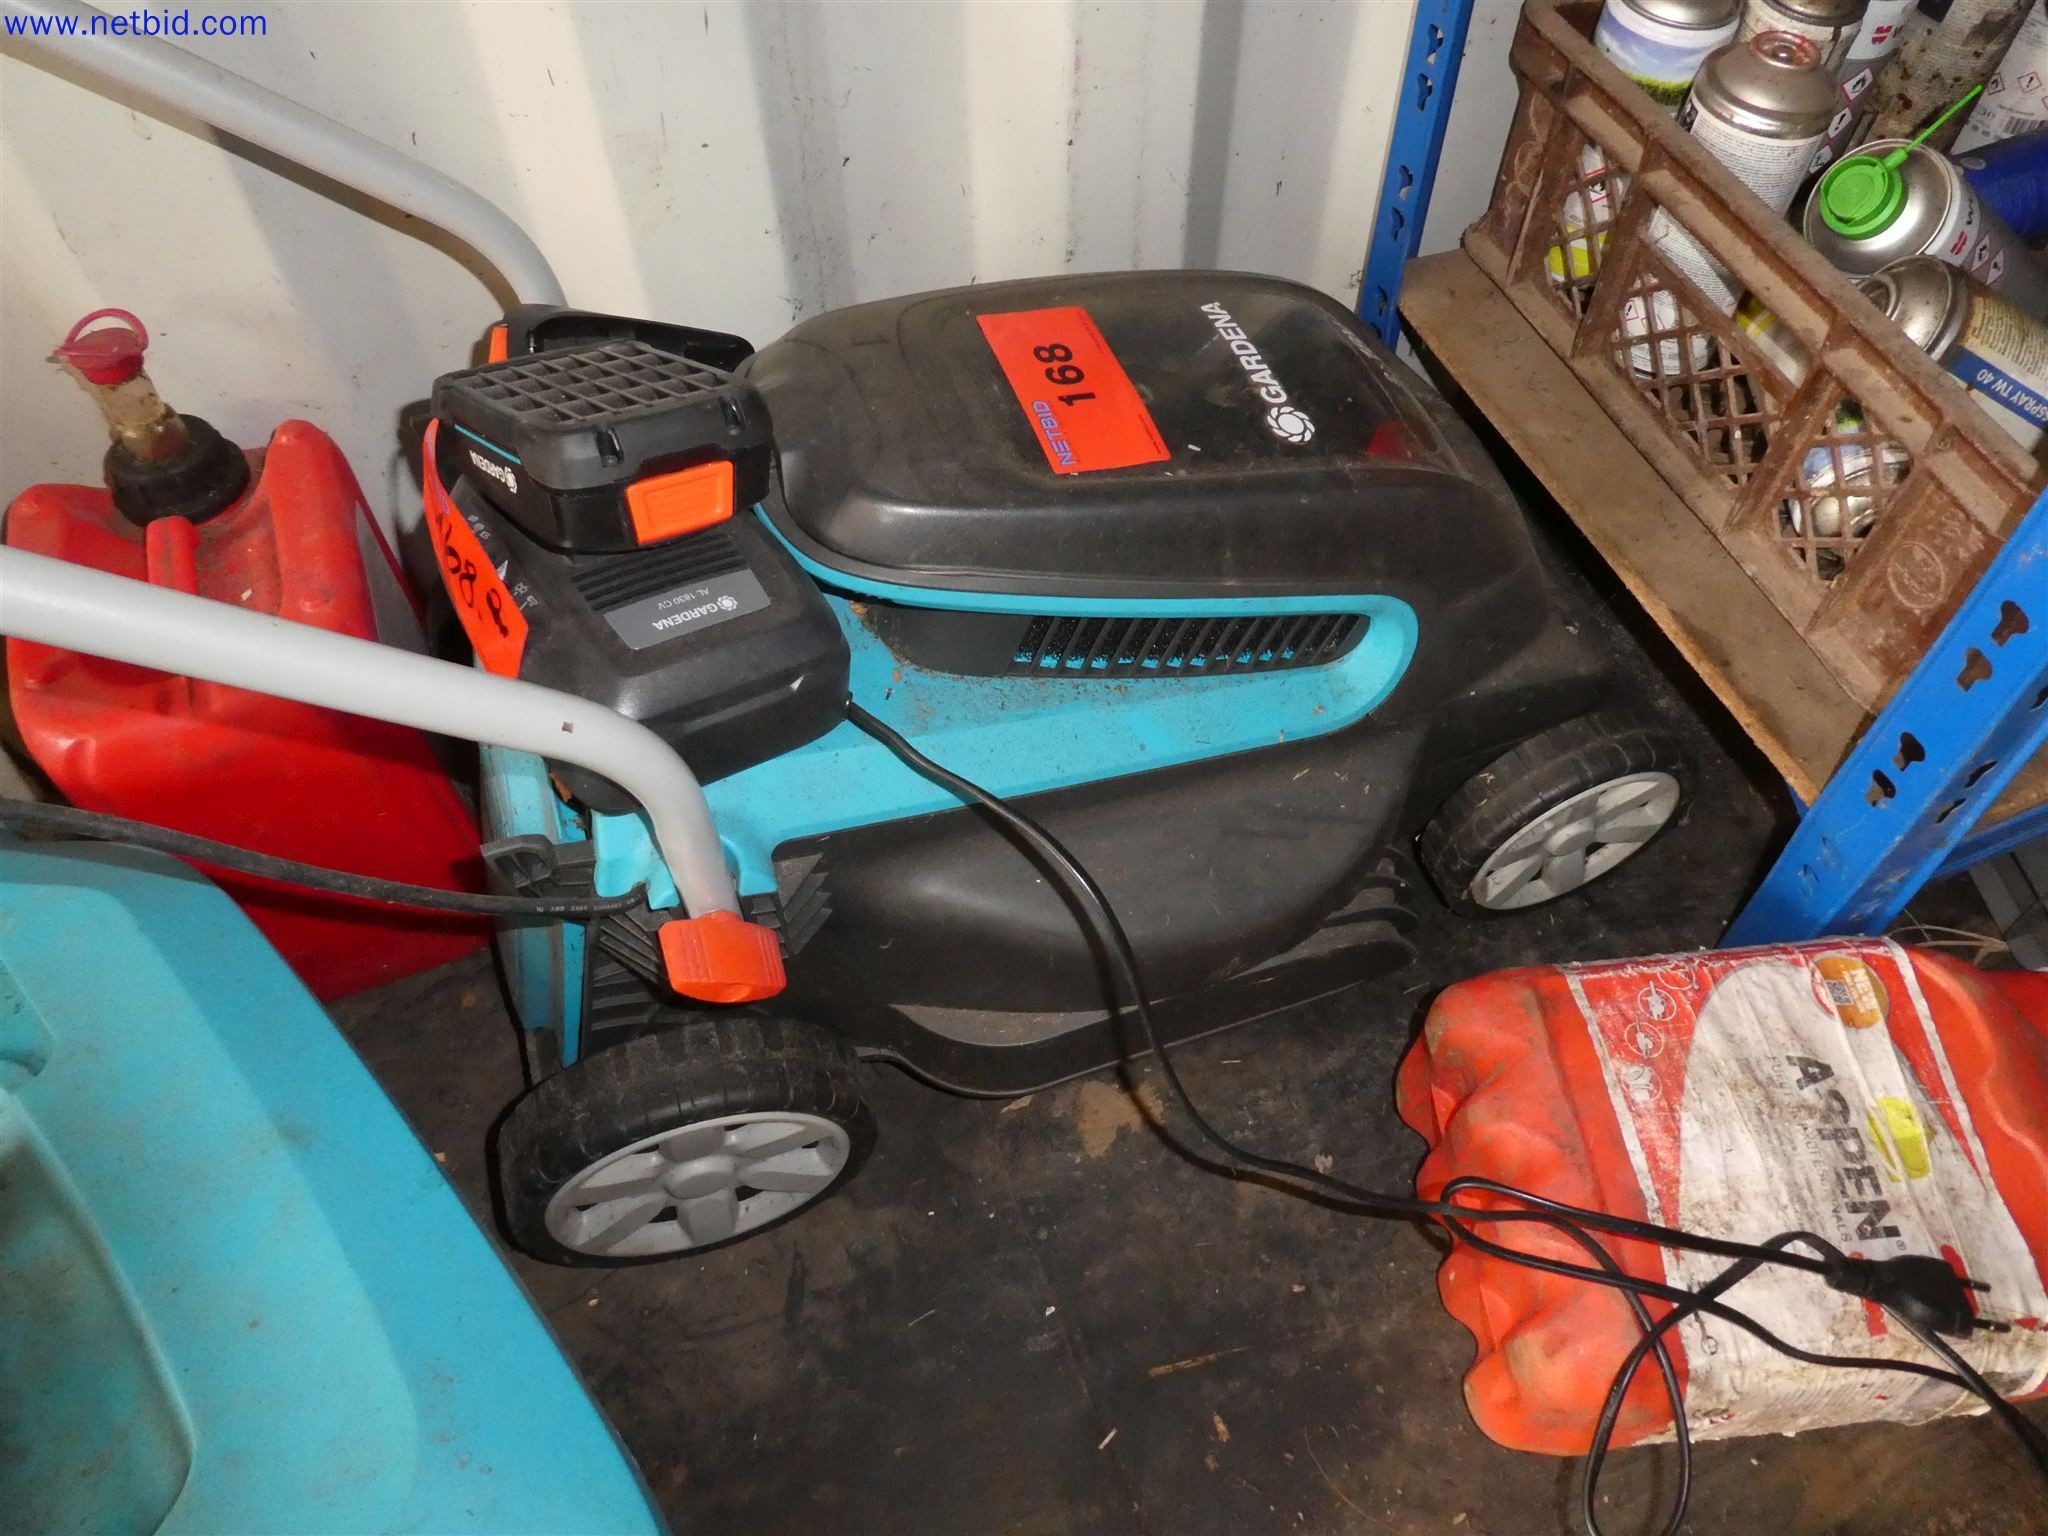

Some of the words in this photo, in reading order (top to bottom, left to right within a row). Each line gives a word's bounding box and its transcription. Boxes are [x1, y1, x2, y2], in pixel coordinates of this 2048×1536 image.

[1033, 343, 1096, 407] 168
[1201, 302, 1288, 404] GARDENA
[1976, 368, 1995, 384] 40
[1031, 400, 1078, 466] NETBID
[652, 602, 718, 631] GARDENA
[658, 601, 673, 610] CV
[673, 592, 696, 604] 1830
[1786, 1055, 1901, 1241] ASPEN
